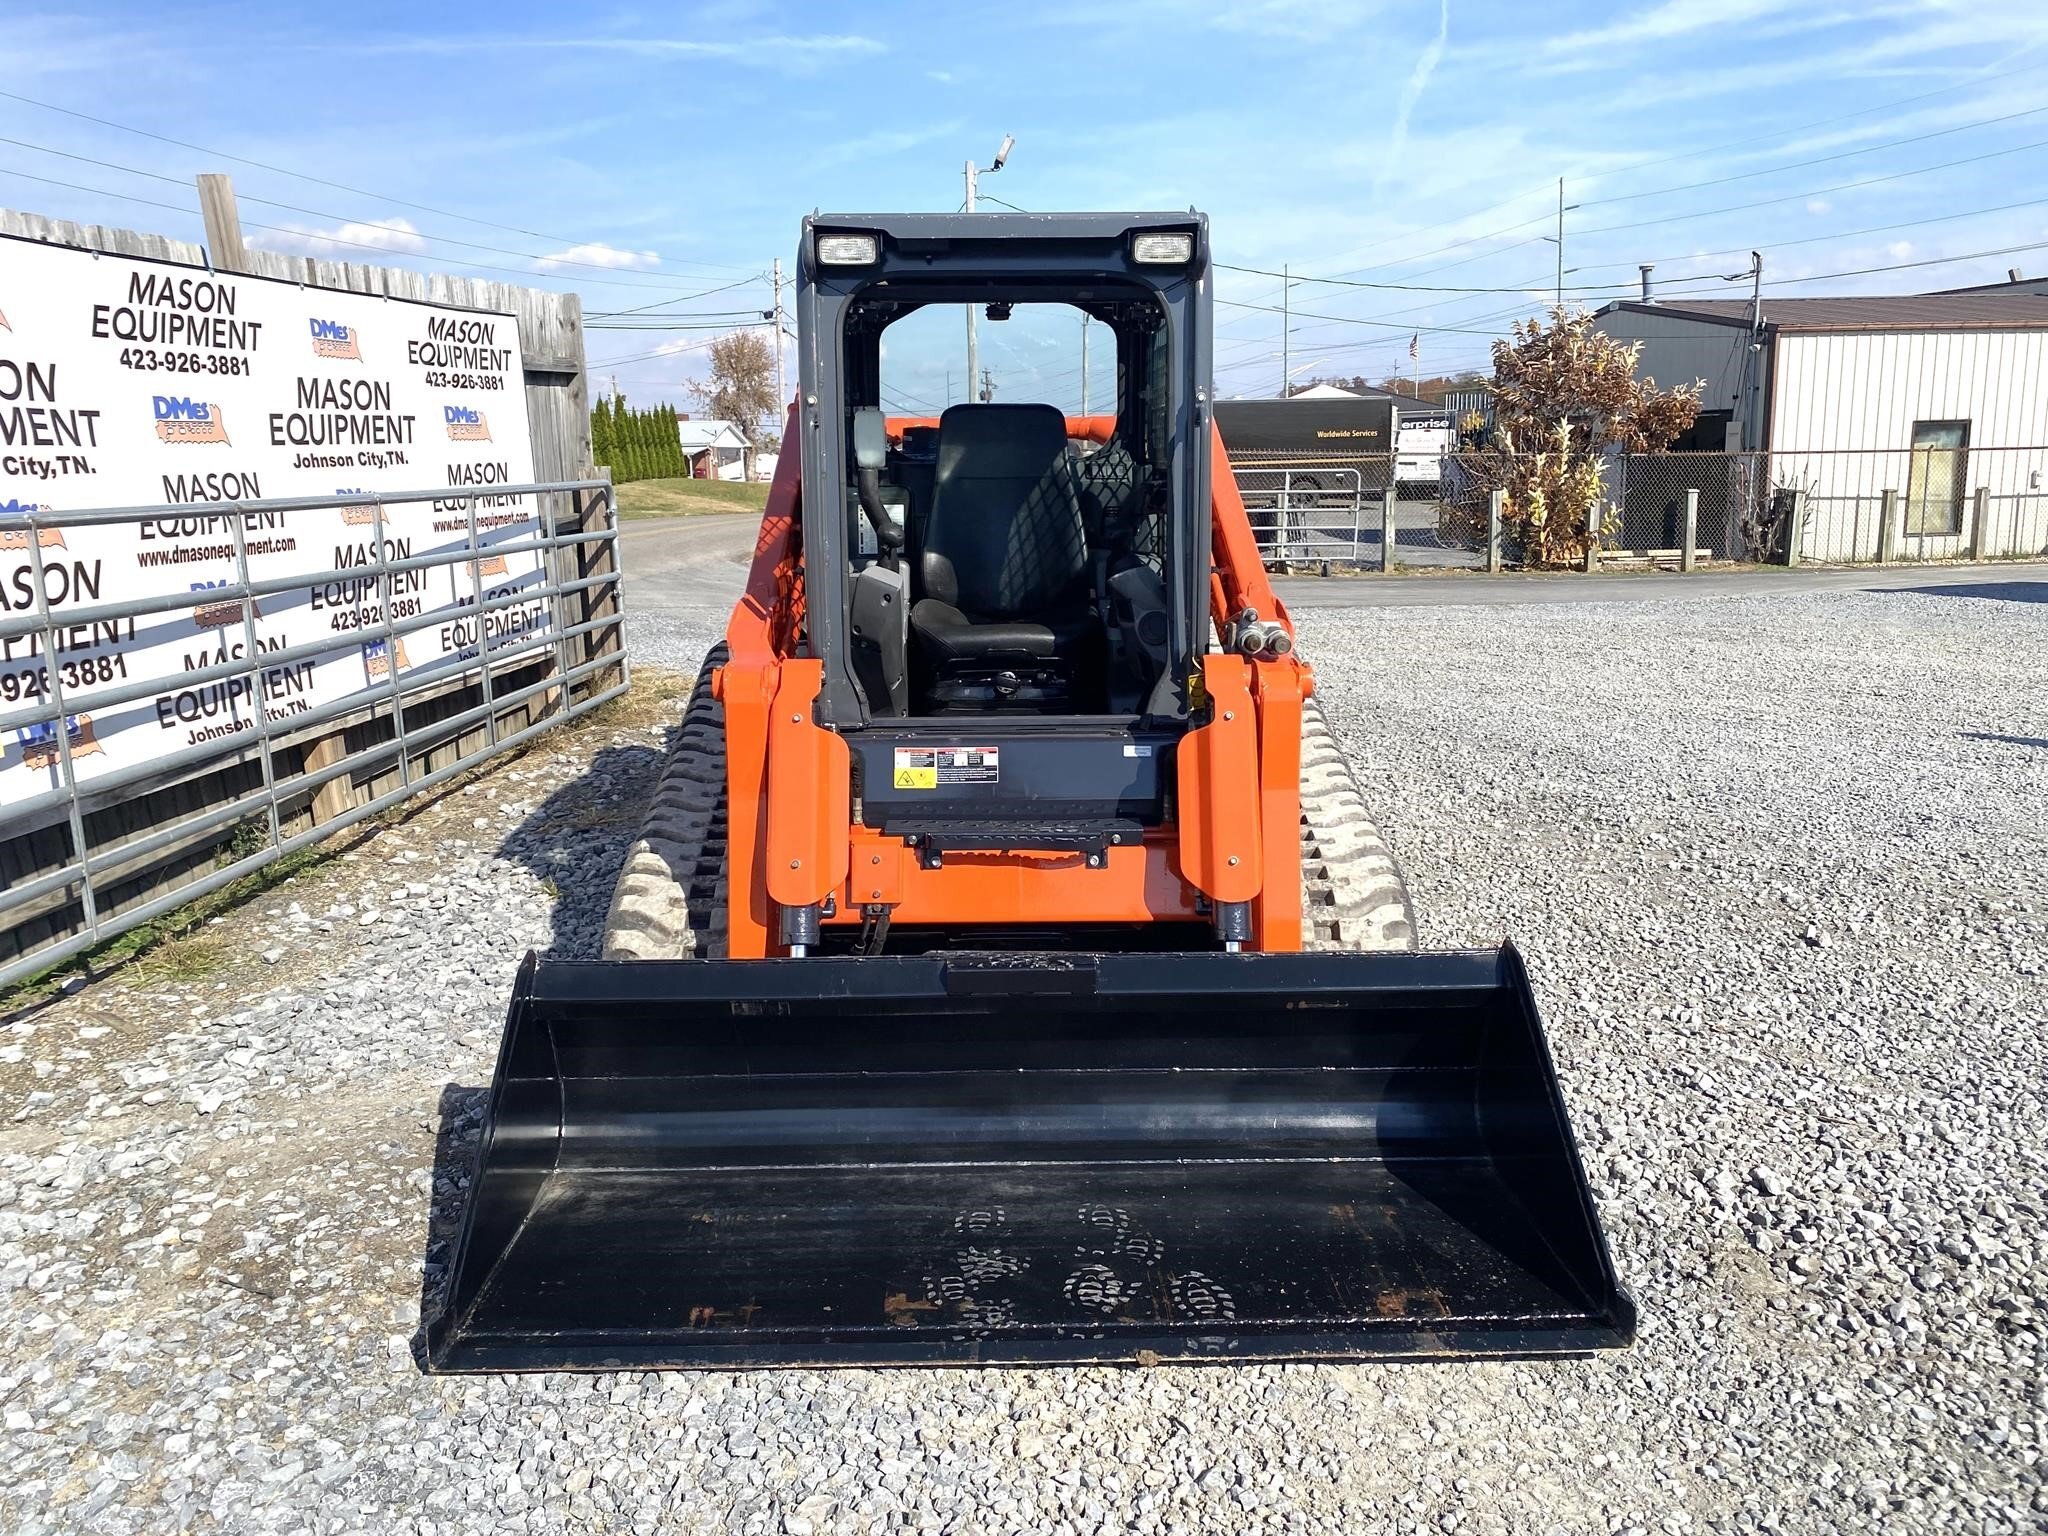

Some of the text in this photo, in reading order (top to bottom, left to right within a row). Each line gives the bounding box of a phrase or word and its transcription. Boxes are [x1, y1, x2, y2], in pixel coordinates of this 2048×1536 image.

[128, 272, 235, 315] MASON
[91, 304, 262, 351] EQUIPMENT
[428, 316, 494, 345] MASON
[120, 348, 250, 376] 423-926-3881
[408, 340, 512, 371] EQUIPMENT
[297, 377, 390, 410] MASON
[425, 371, 504, 390] 423-926-3881
[269, 413, 415, 445] EQUIPMENT
[1317, 430, 1351, 438] Worldwide
[293, 453, 354, 469] Johnson
[447, 462, 507, 486] MASON
[162, 471, 261, 503] MASON
[441, 607, 542, 652] EQUPMENT
[187, 717, 253, 746] Johnson
